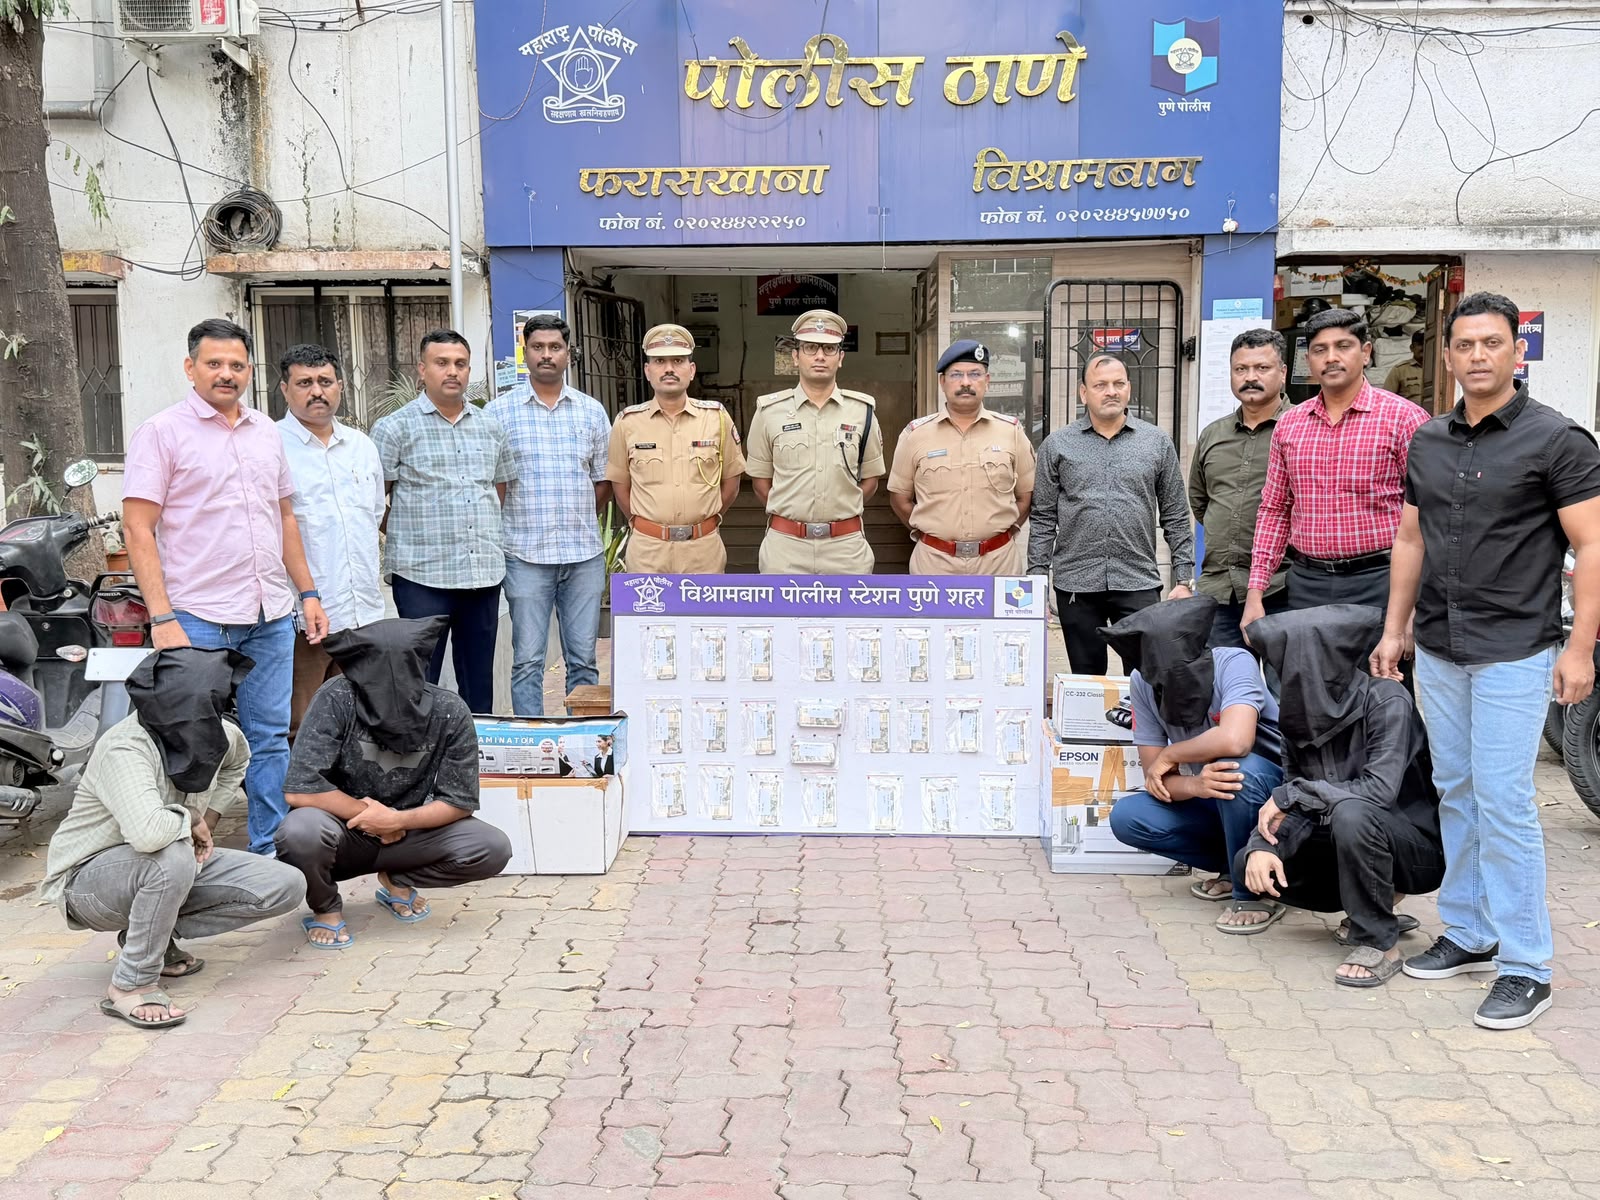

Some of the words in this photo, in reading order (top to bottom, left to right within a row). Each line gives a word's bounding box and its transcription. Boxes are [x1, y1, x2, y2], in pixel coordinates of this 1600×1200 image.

[518, 25, 570, 55] महाराष्ट्र
[588, 22, 638, 55] पोलीस
[684, 33, 925, 108] पोलीस
[943, 30, 1088, 106] ठाणे
[1158, 98, 1175, 116] पुणे
[1177, 98, 1211, 112] पोलीस
[973, 147, 1203, 193] विश्रामबाग
[579, 165, 831, 198] फरासखाना
[599, 212, 641, 231] फोन
[644, 211, 666, 231] नं.
[674, 215, 806, 231] ०२०२४४२२२५०
[979, 206, 1022, 225] फोन
[1025, 204, 1047, 224] नं.
[1056, 206, 1190, 223] ०२०२४४५७७५०
[769, 296, 781, 308] पुणे
[784, 298, 800, 306] शहर
[802, 295, 827, 305] पोलीस
[1518, 321, 1542, 334] ारित्र्य
[679, 579, 774, 603] विश्रामबाग
[780, 579, 842, 605] पोलीस
[848, 580, 901, 605] स्टेशन
[907, 581, 940, 612] पुणे
[945, 588, 985, 609] शहर
[478, 736, 534, 744] AMINATOR
[1059, 752, 1099, 761] EPSON
